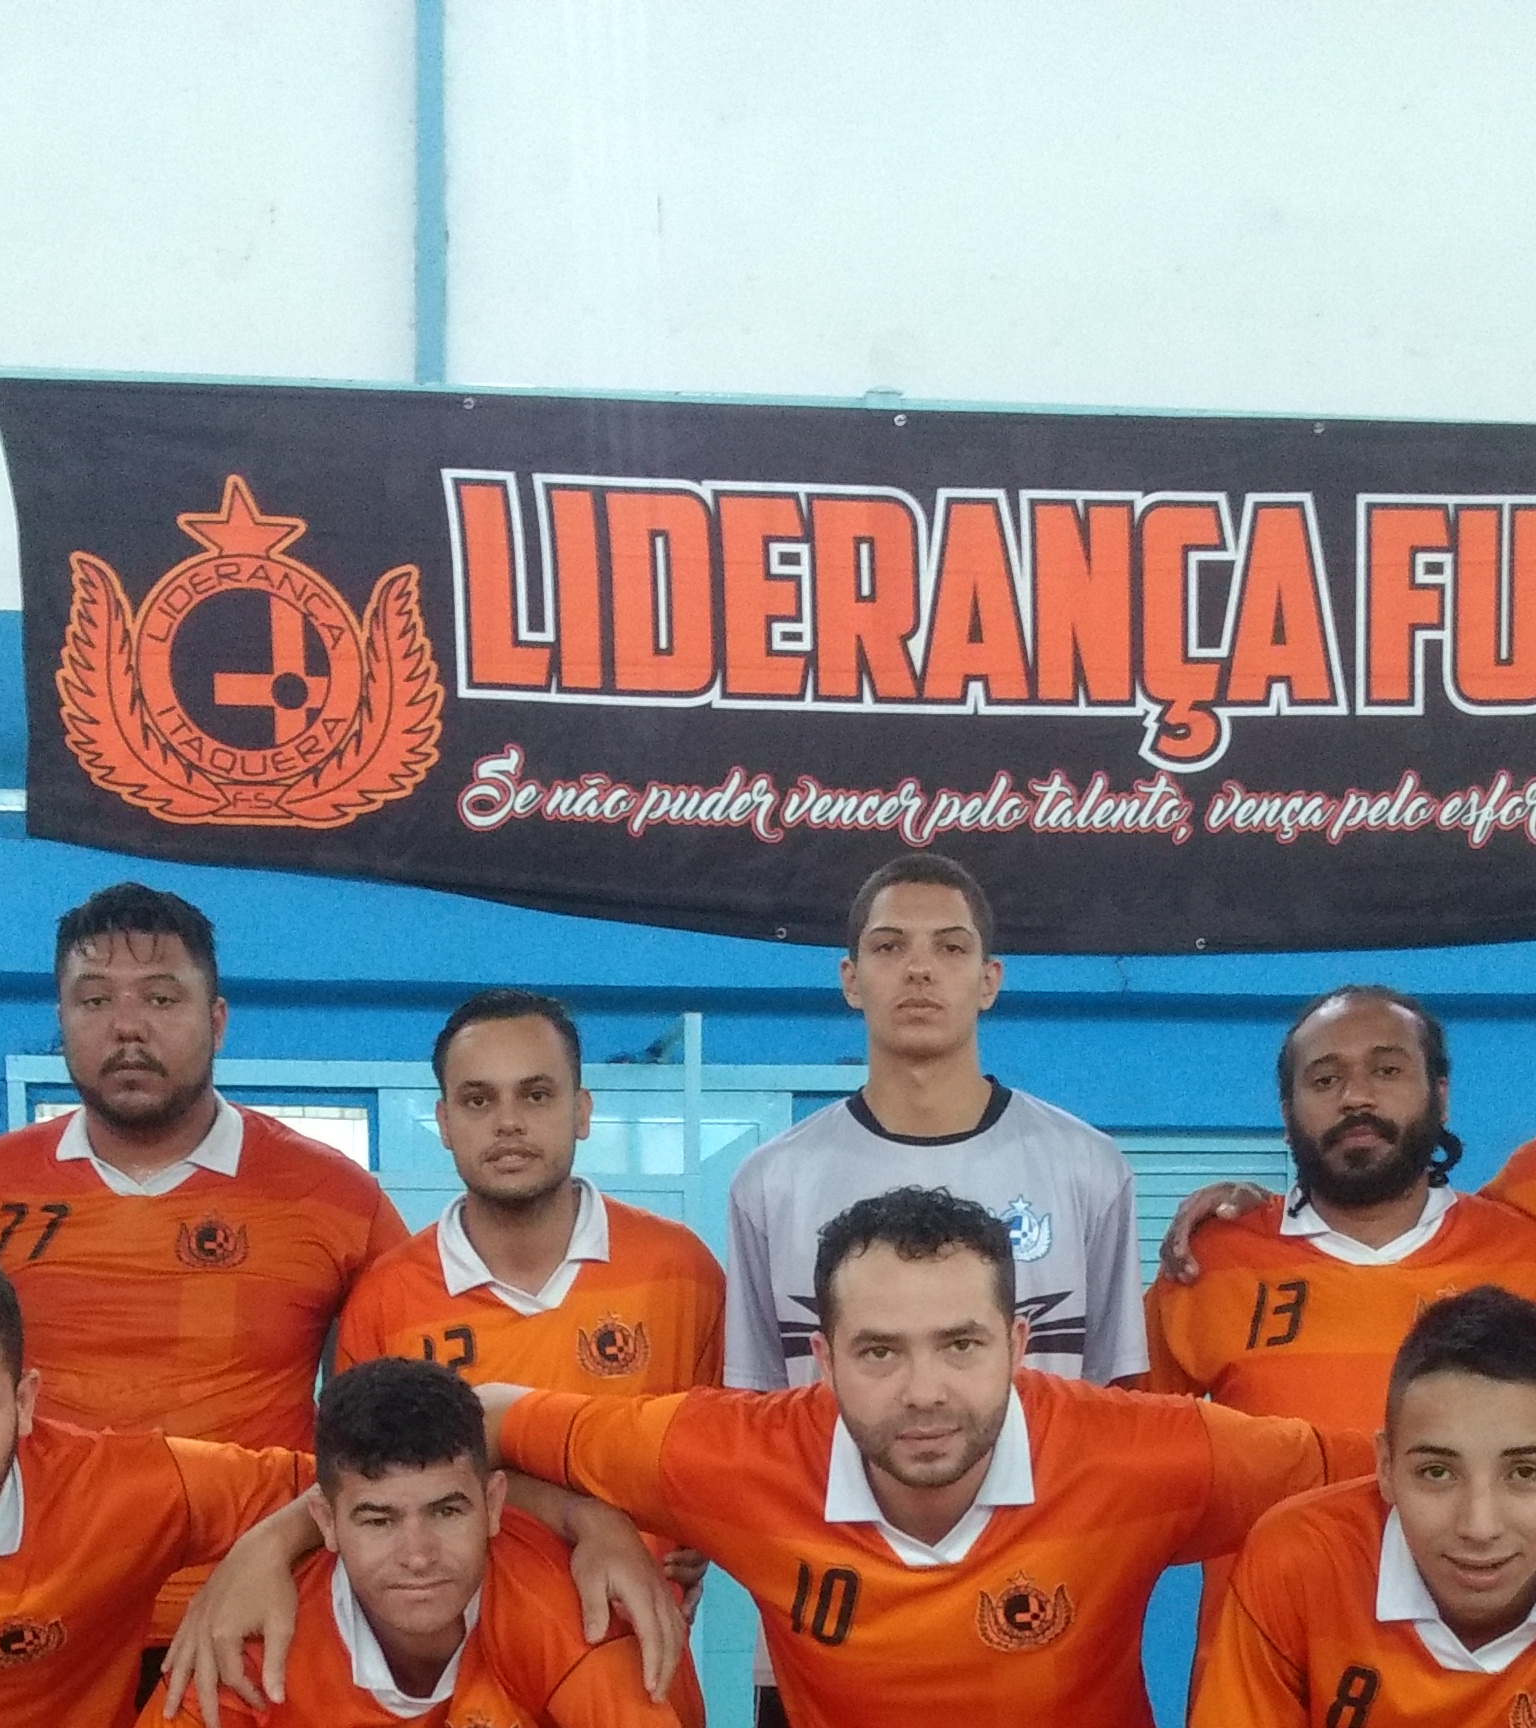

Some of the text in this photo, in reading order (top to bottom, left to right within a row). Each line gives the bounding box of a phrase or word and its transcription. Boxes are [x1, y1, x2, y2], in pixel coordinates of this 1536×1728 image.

[441, 470, 1348, 772] LIDERANÇA
[157, 704, 347, 776] ITAQUERA
[232, 792, 275, 809] FS
[461, 745, 545, 830] Se
[544, 776, 637, 820] não
[628, 768, 782, 842] puder
[783, 778, 933, 845] vencer
[924, 774, 1031, 840] pelo
[1028, 774, 1193, 843] talento,
[1210, 783, 1336, 842] vença
[1330, 773, 1439, 842] pelo
[1245, 1278, 1310, 1352] 13
[790, 1557, 861, 1648] 10
